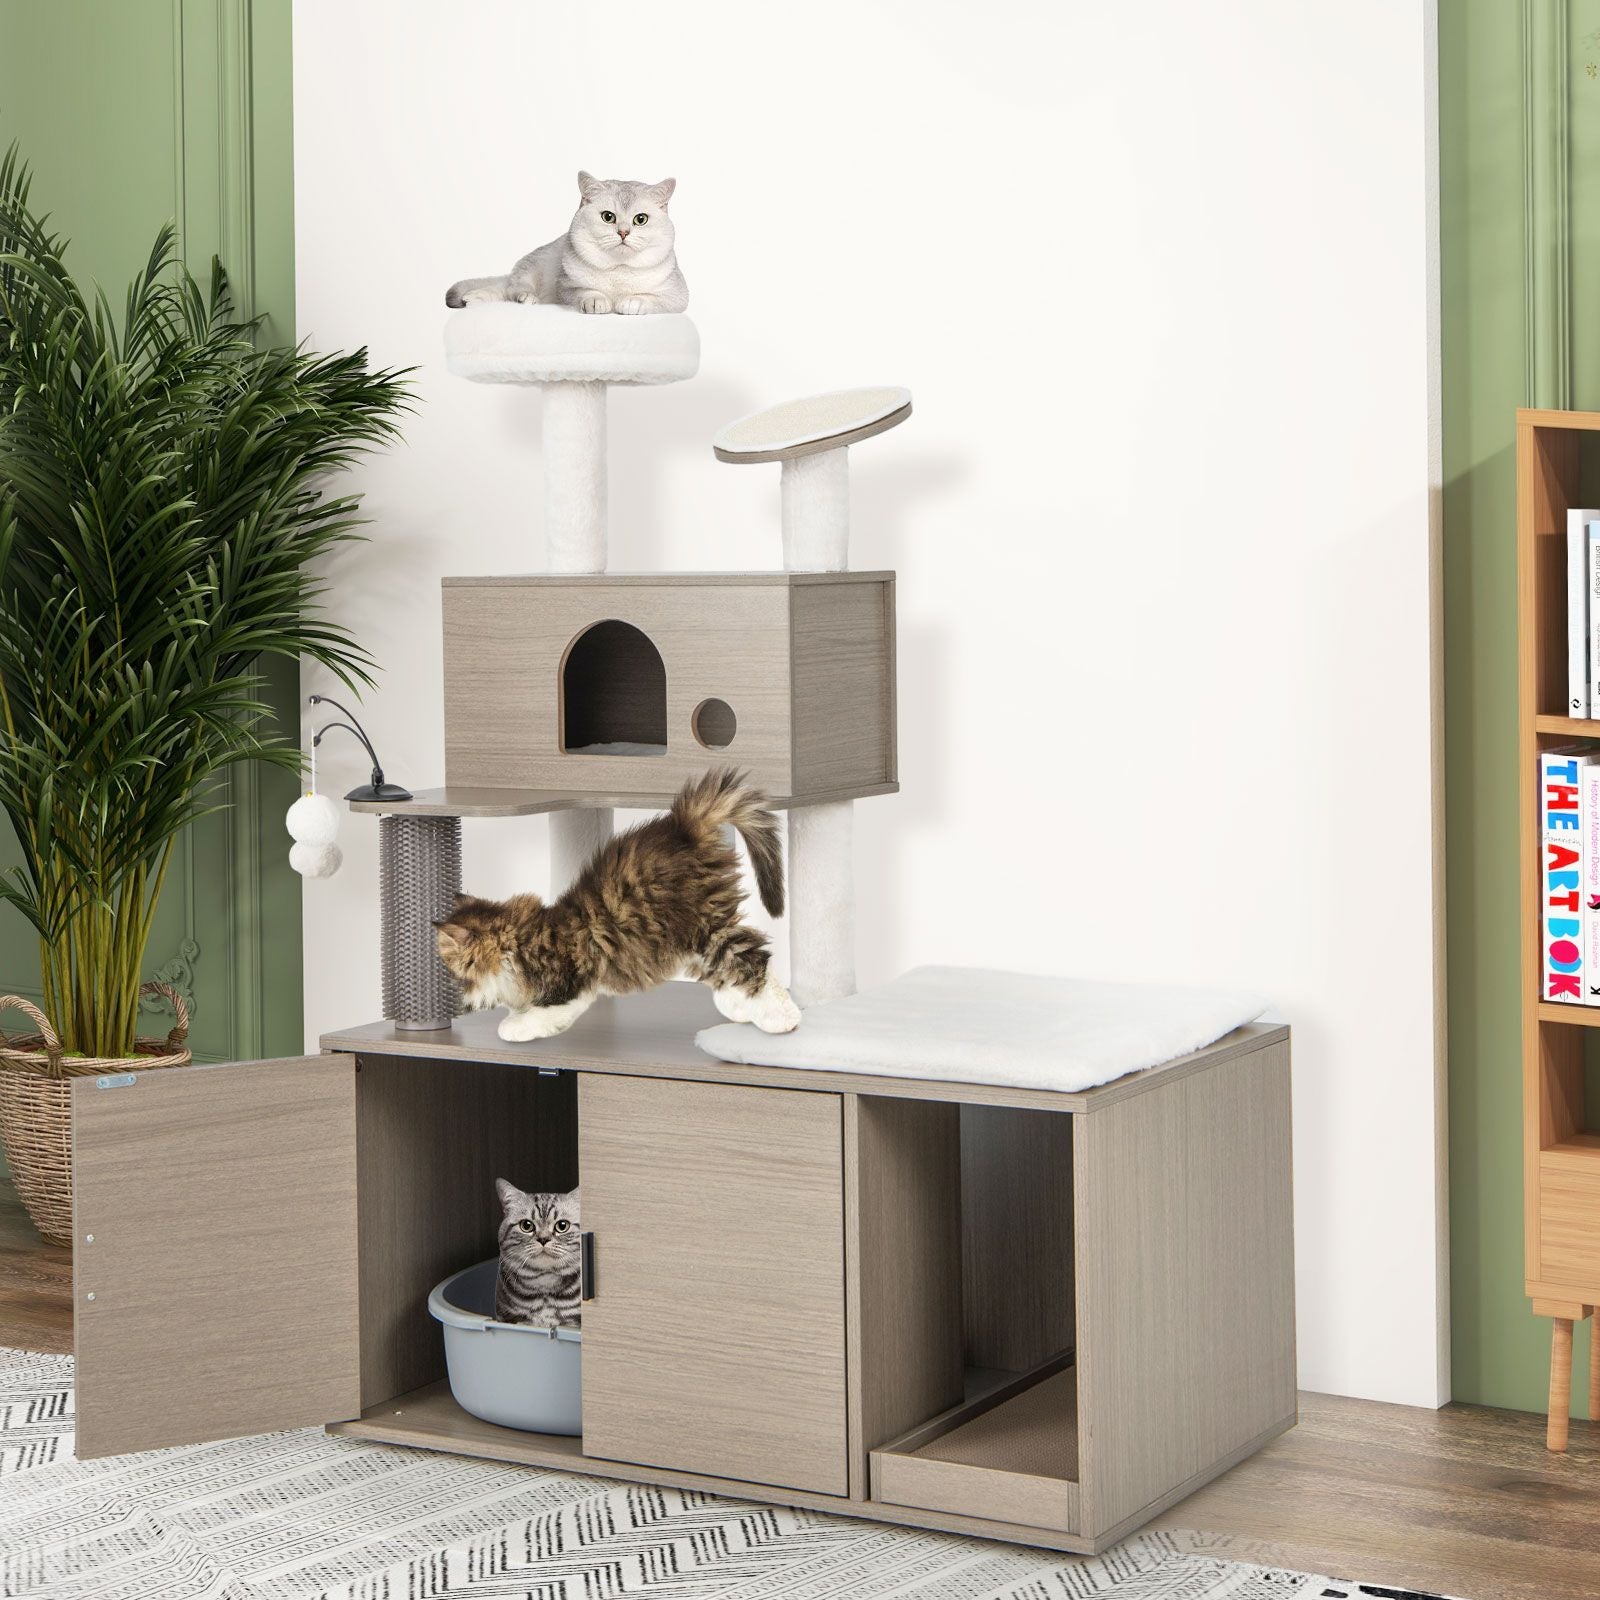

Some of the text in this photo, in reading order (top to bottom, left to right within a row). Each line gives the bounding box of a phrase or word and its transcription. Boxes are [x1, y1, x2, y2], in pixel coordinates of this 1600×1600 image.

[1546, 760, 1582, 998] THE ART BOOK
[1590, 780, 1600, 885] History of Modern Design
